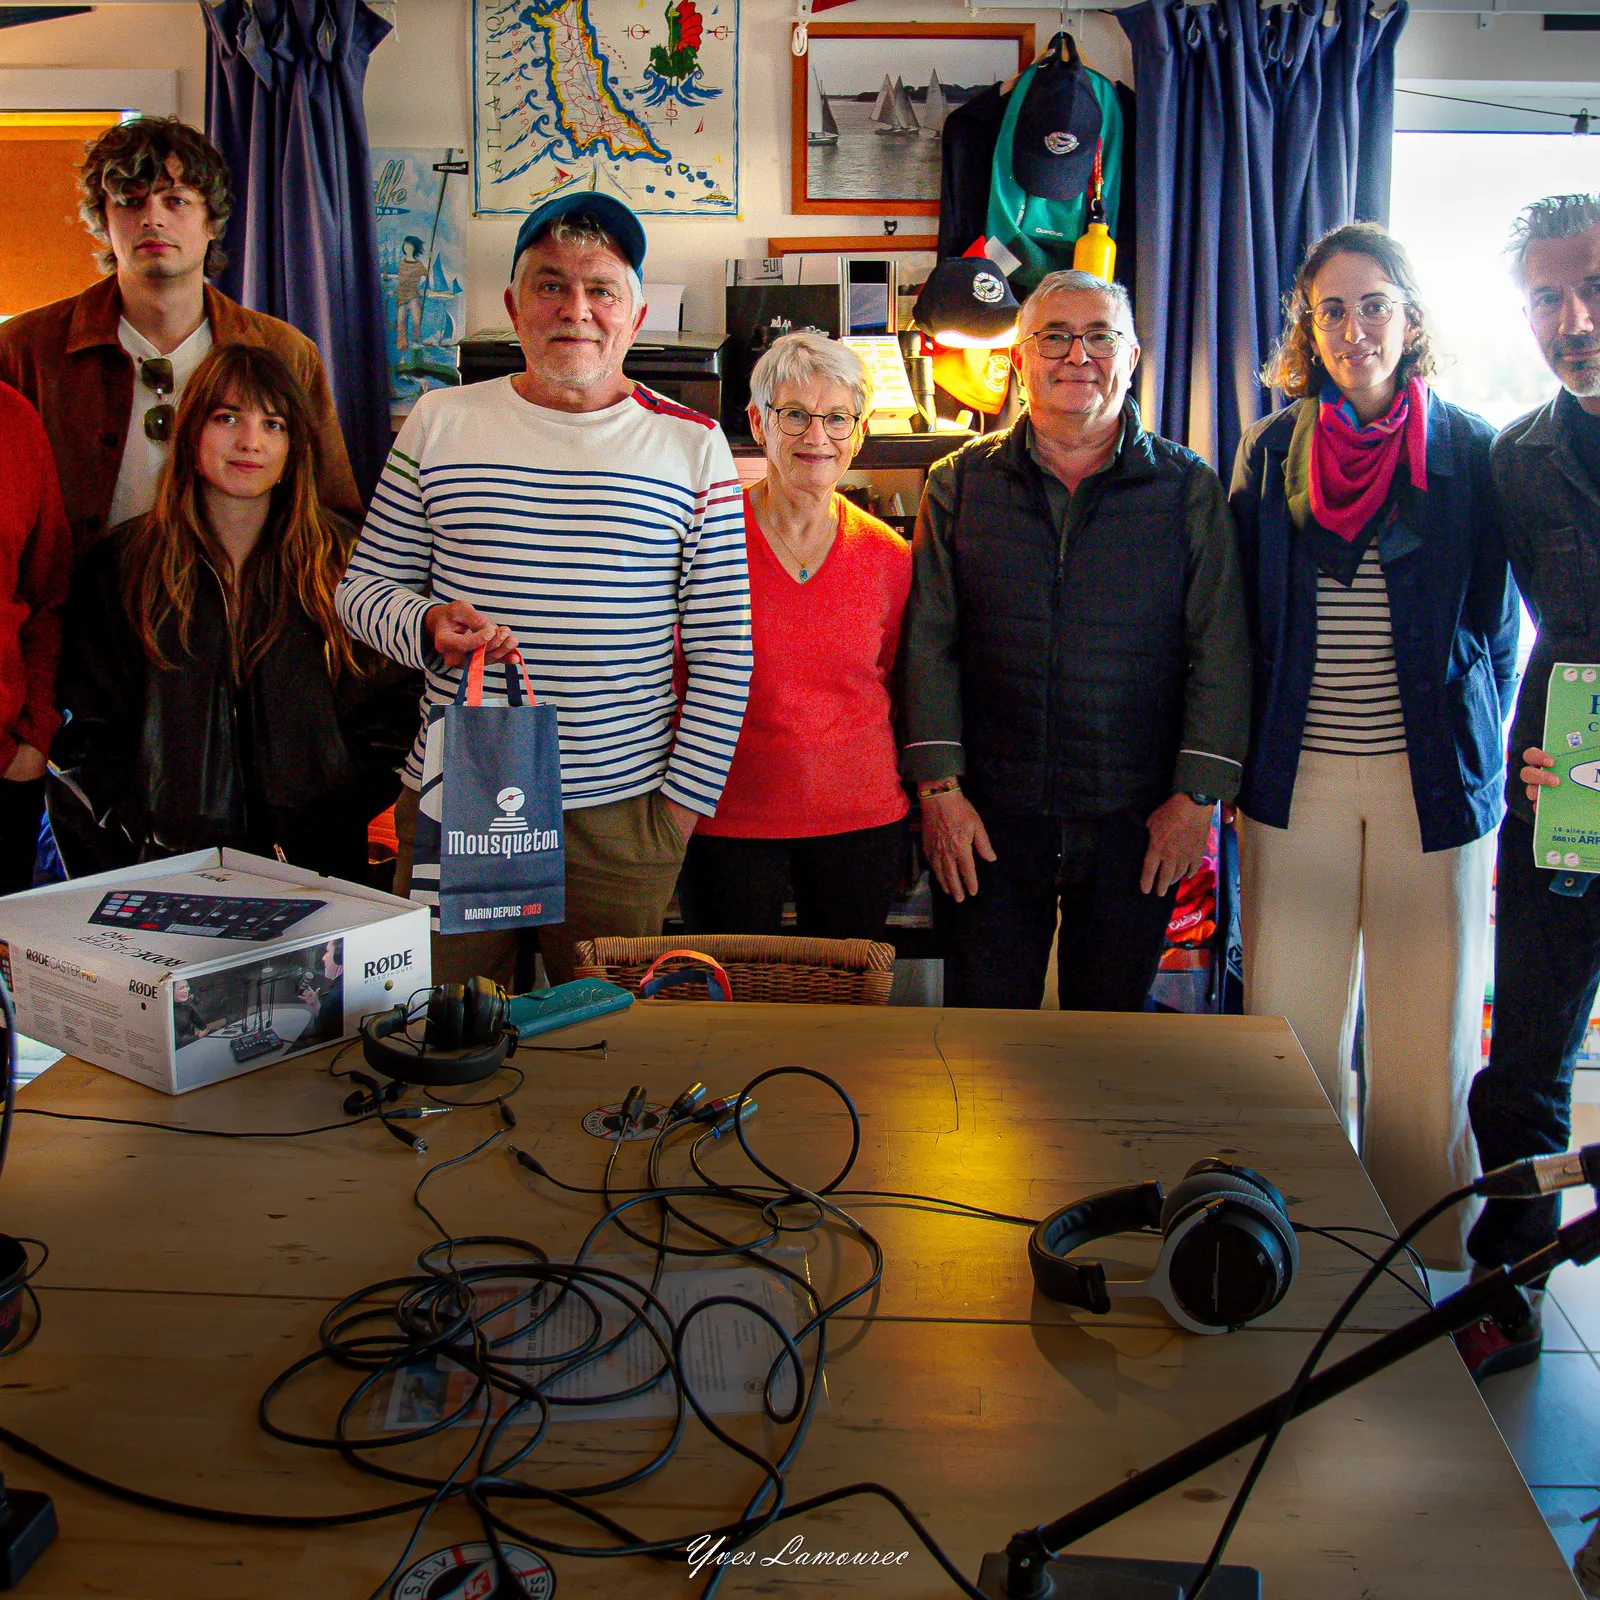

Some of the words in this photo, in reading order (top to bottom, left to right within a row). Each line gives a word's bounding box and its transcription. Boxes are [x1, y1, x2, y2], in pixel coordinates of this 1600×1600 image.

[448, 828, 560, 860] Mousqueton
[464, 906, 492, 920] MARIN
[493, 904, 521, 919] DEPUIS
[522, 904, 542, 916] 2003
[364, 949, 413, 979] RØDE
[364, 966, 413, 984] MICROPHONES
[128, 979, 158, 999] RØDE
